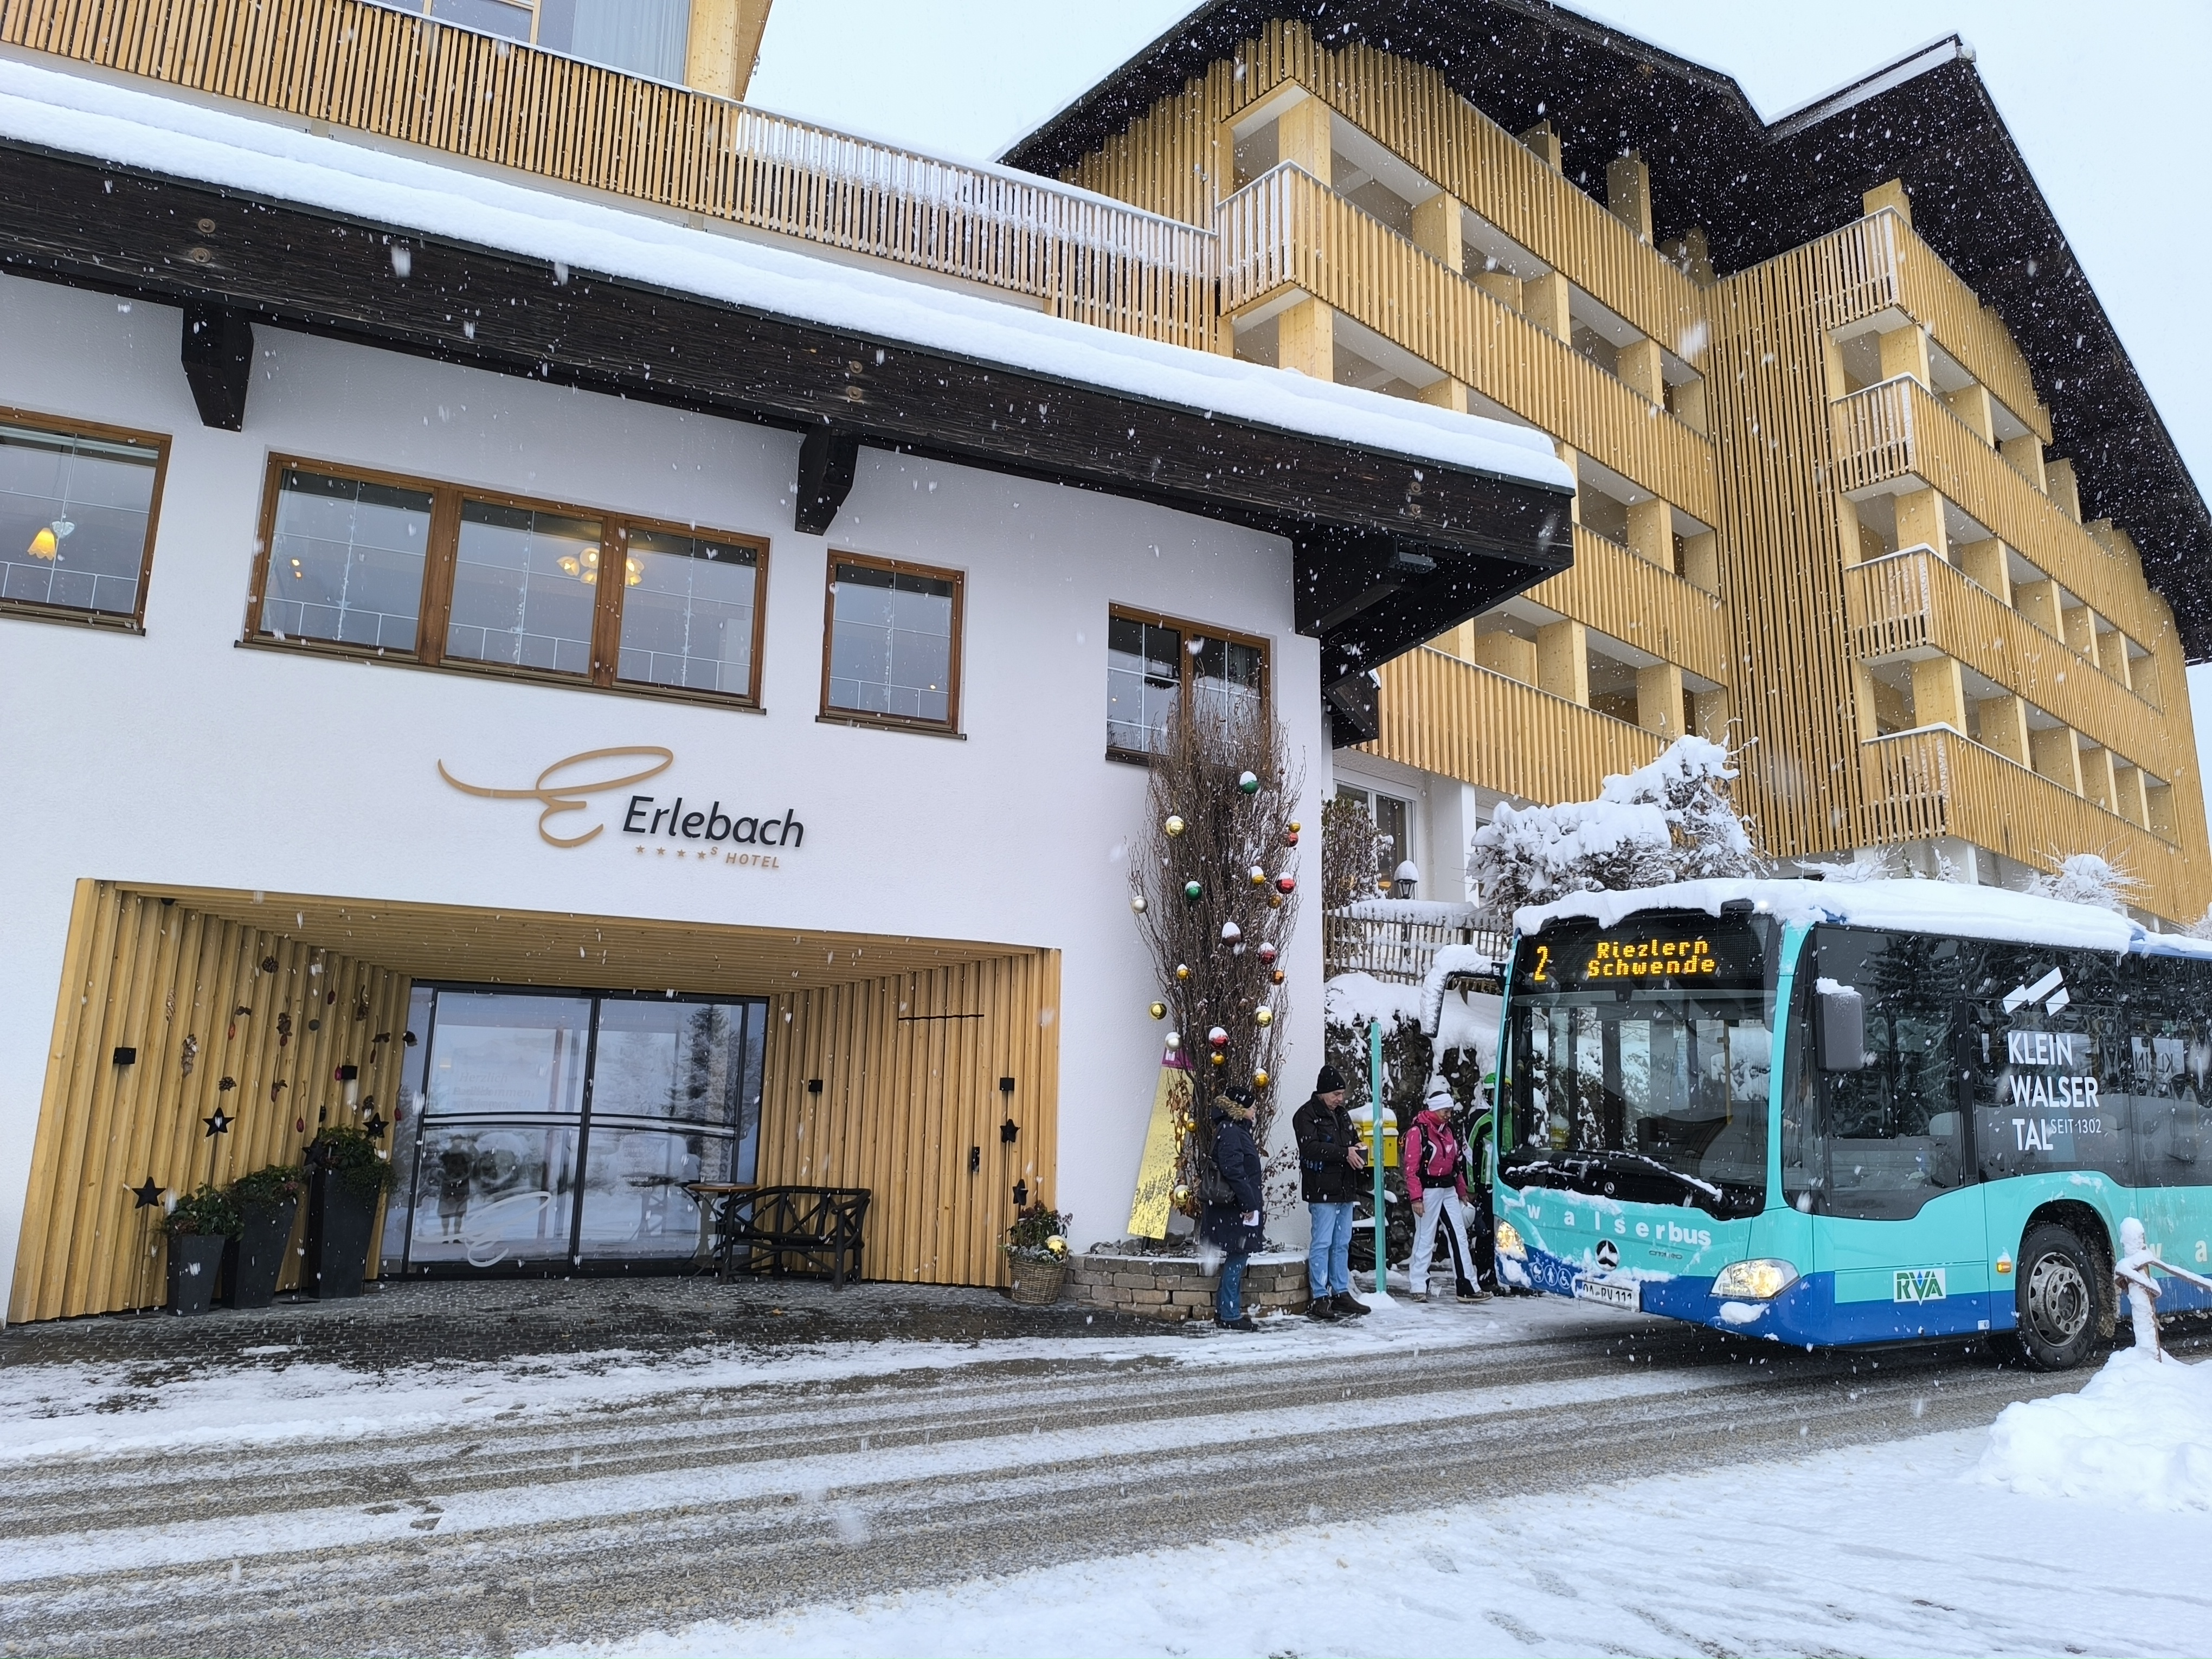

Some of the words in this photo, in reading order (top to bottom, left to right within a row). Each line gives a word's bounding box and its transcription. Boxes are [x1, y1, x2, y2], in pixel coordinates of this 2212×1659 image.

[623, 795, 804, 847] Erlebach
[725, 852, 779, 868] HOTEL
[1535, 946, 1548, 981] 2
[1597, 939, 1708, 959] Riezlern
[1588, 955, 1715, 976] Schwende
[2008, 1032, 2073, 1066] KLEIN
[459, 1072, 508, 1083] Herzlich
[2009, 1075, 2099, 1108] WALSER
[2012, 1118, 2053, 1150] TAL
[2050, 1118, 2074, 1134] SEIT
[2077, 1118, 2102, 1134] 1302
[1896, 1271, 1943, 1301] RVA
